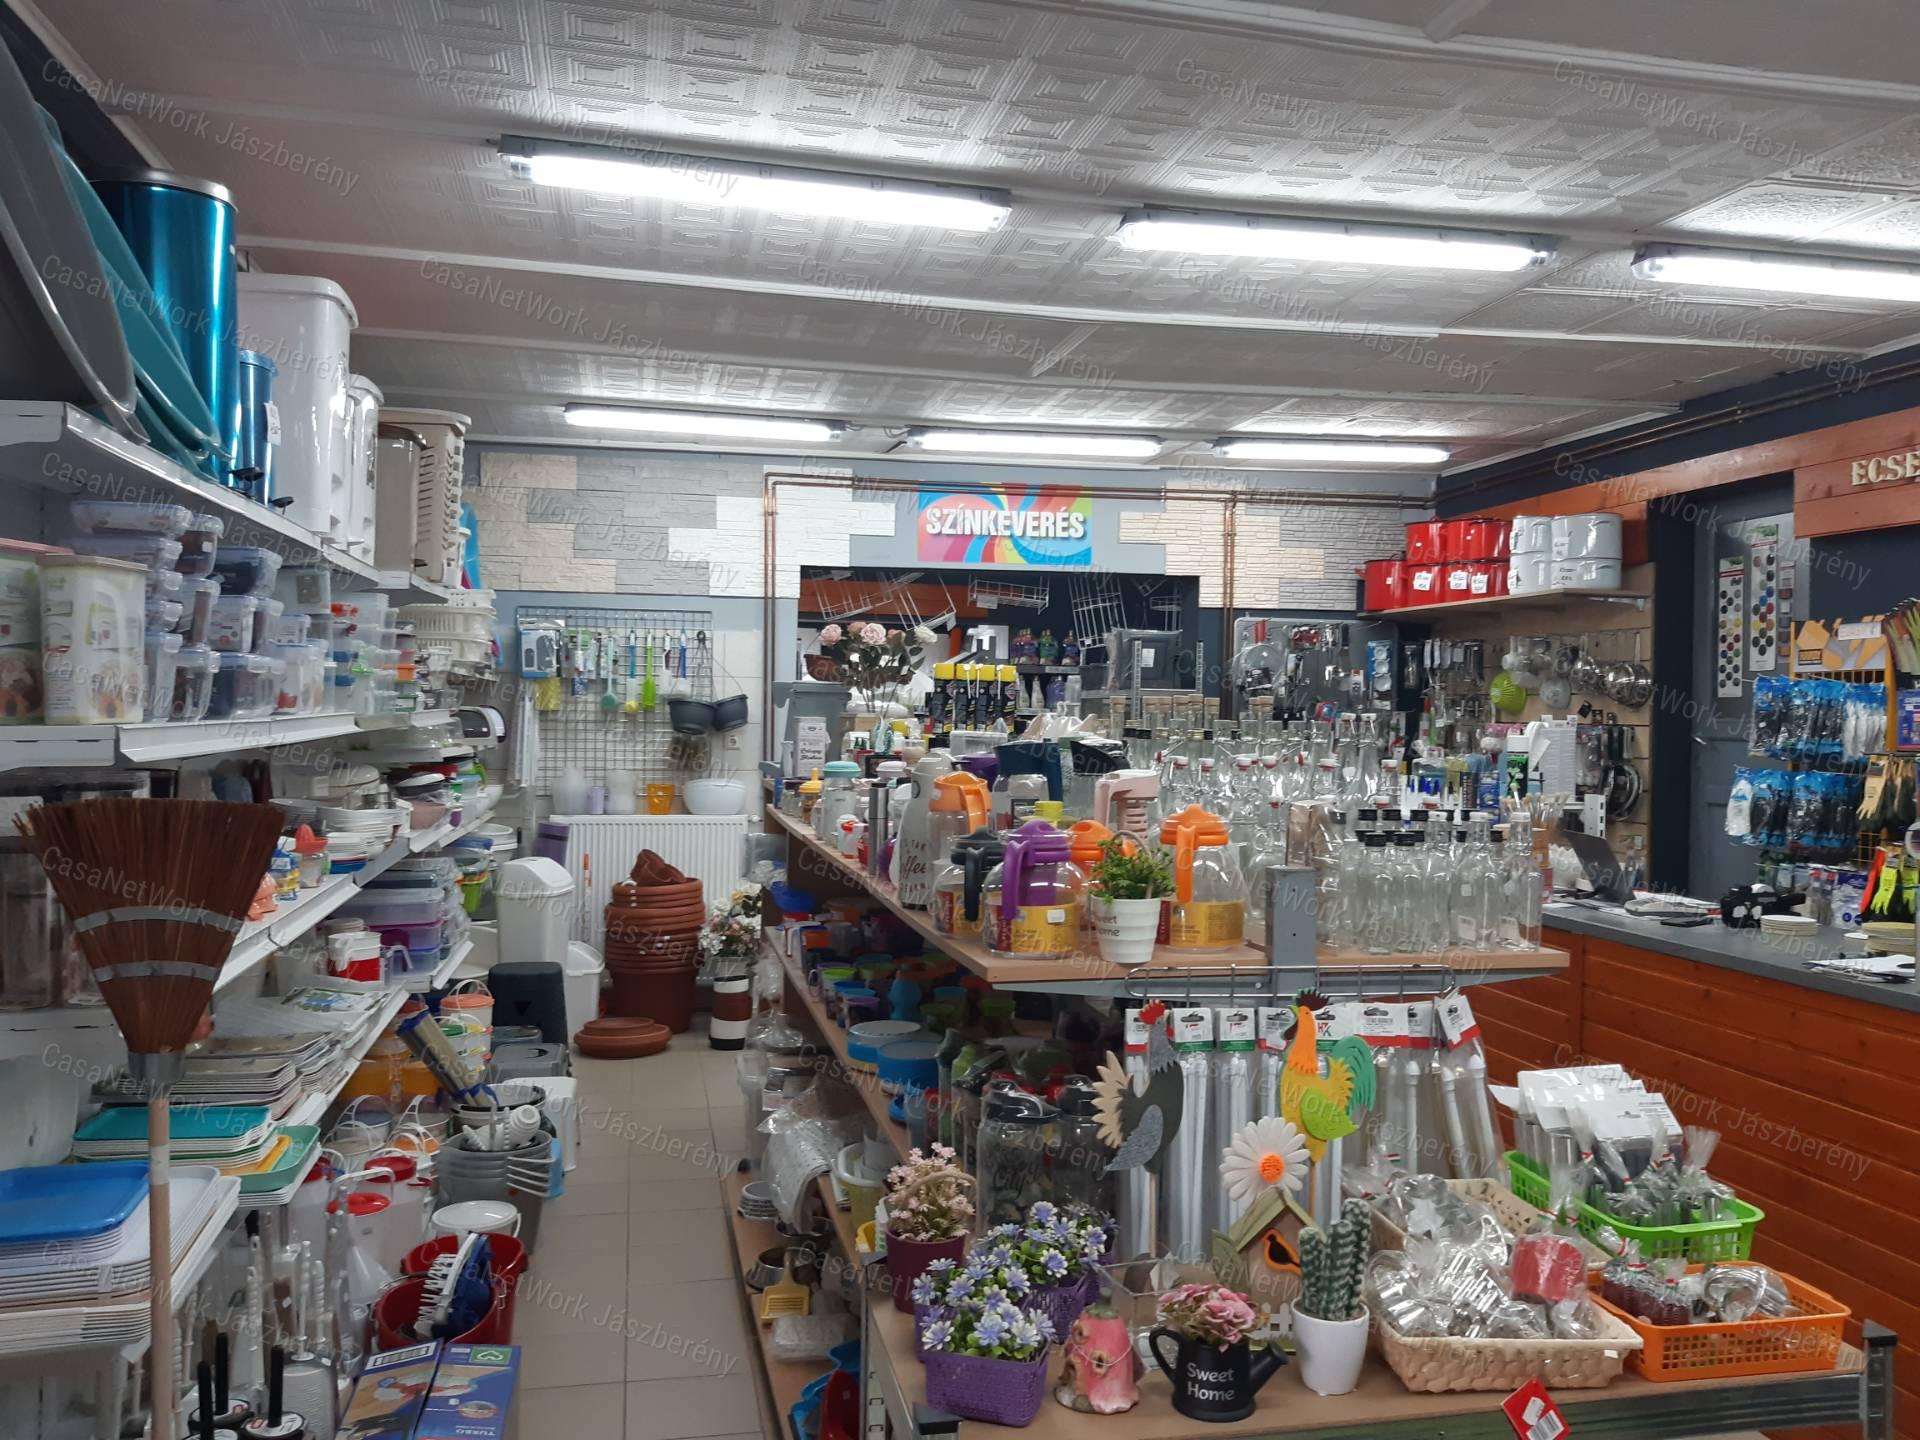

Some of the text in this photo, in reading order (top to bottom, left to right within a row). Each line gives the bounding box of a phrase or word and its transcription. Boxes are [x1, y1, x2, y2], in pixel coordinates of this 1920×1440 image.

[926, 503, 1086, 538] SZÍNKEVERÉS
[1187, 1362, 1235, 1382] Sweet
[1187, 1382, 1235, 1401] Home
